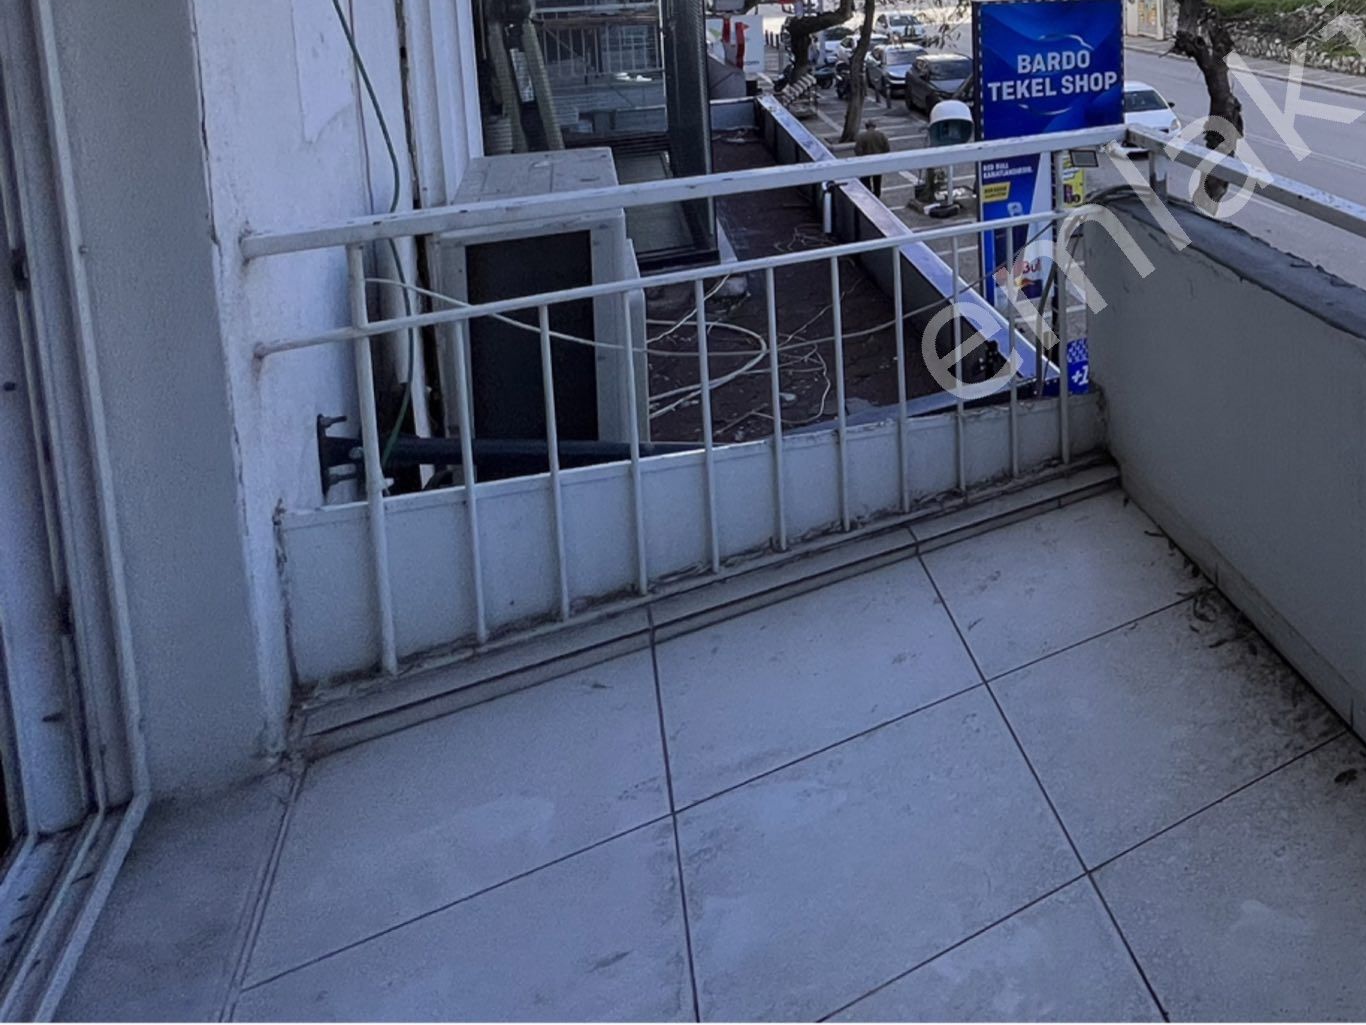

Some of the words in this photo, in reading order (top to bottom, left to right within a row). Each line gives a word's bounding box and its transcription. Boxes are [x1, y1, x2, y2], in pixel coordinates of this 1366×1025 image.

[1017, 50, 1091, 74] BARDO
[988, 77, 1057, 101] TEKEL
[1061, 71, 1117, 94] SHOP
